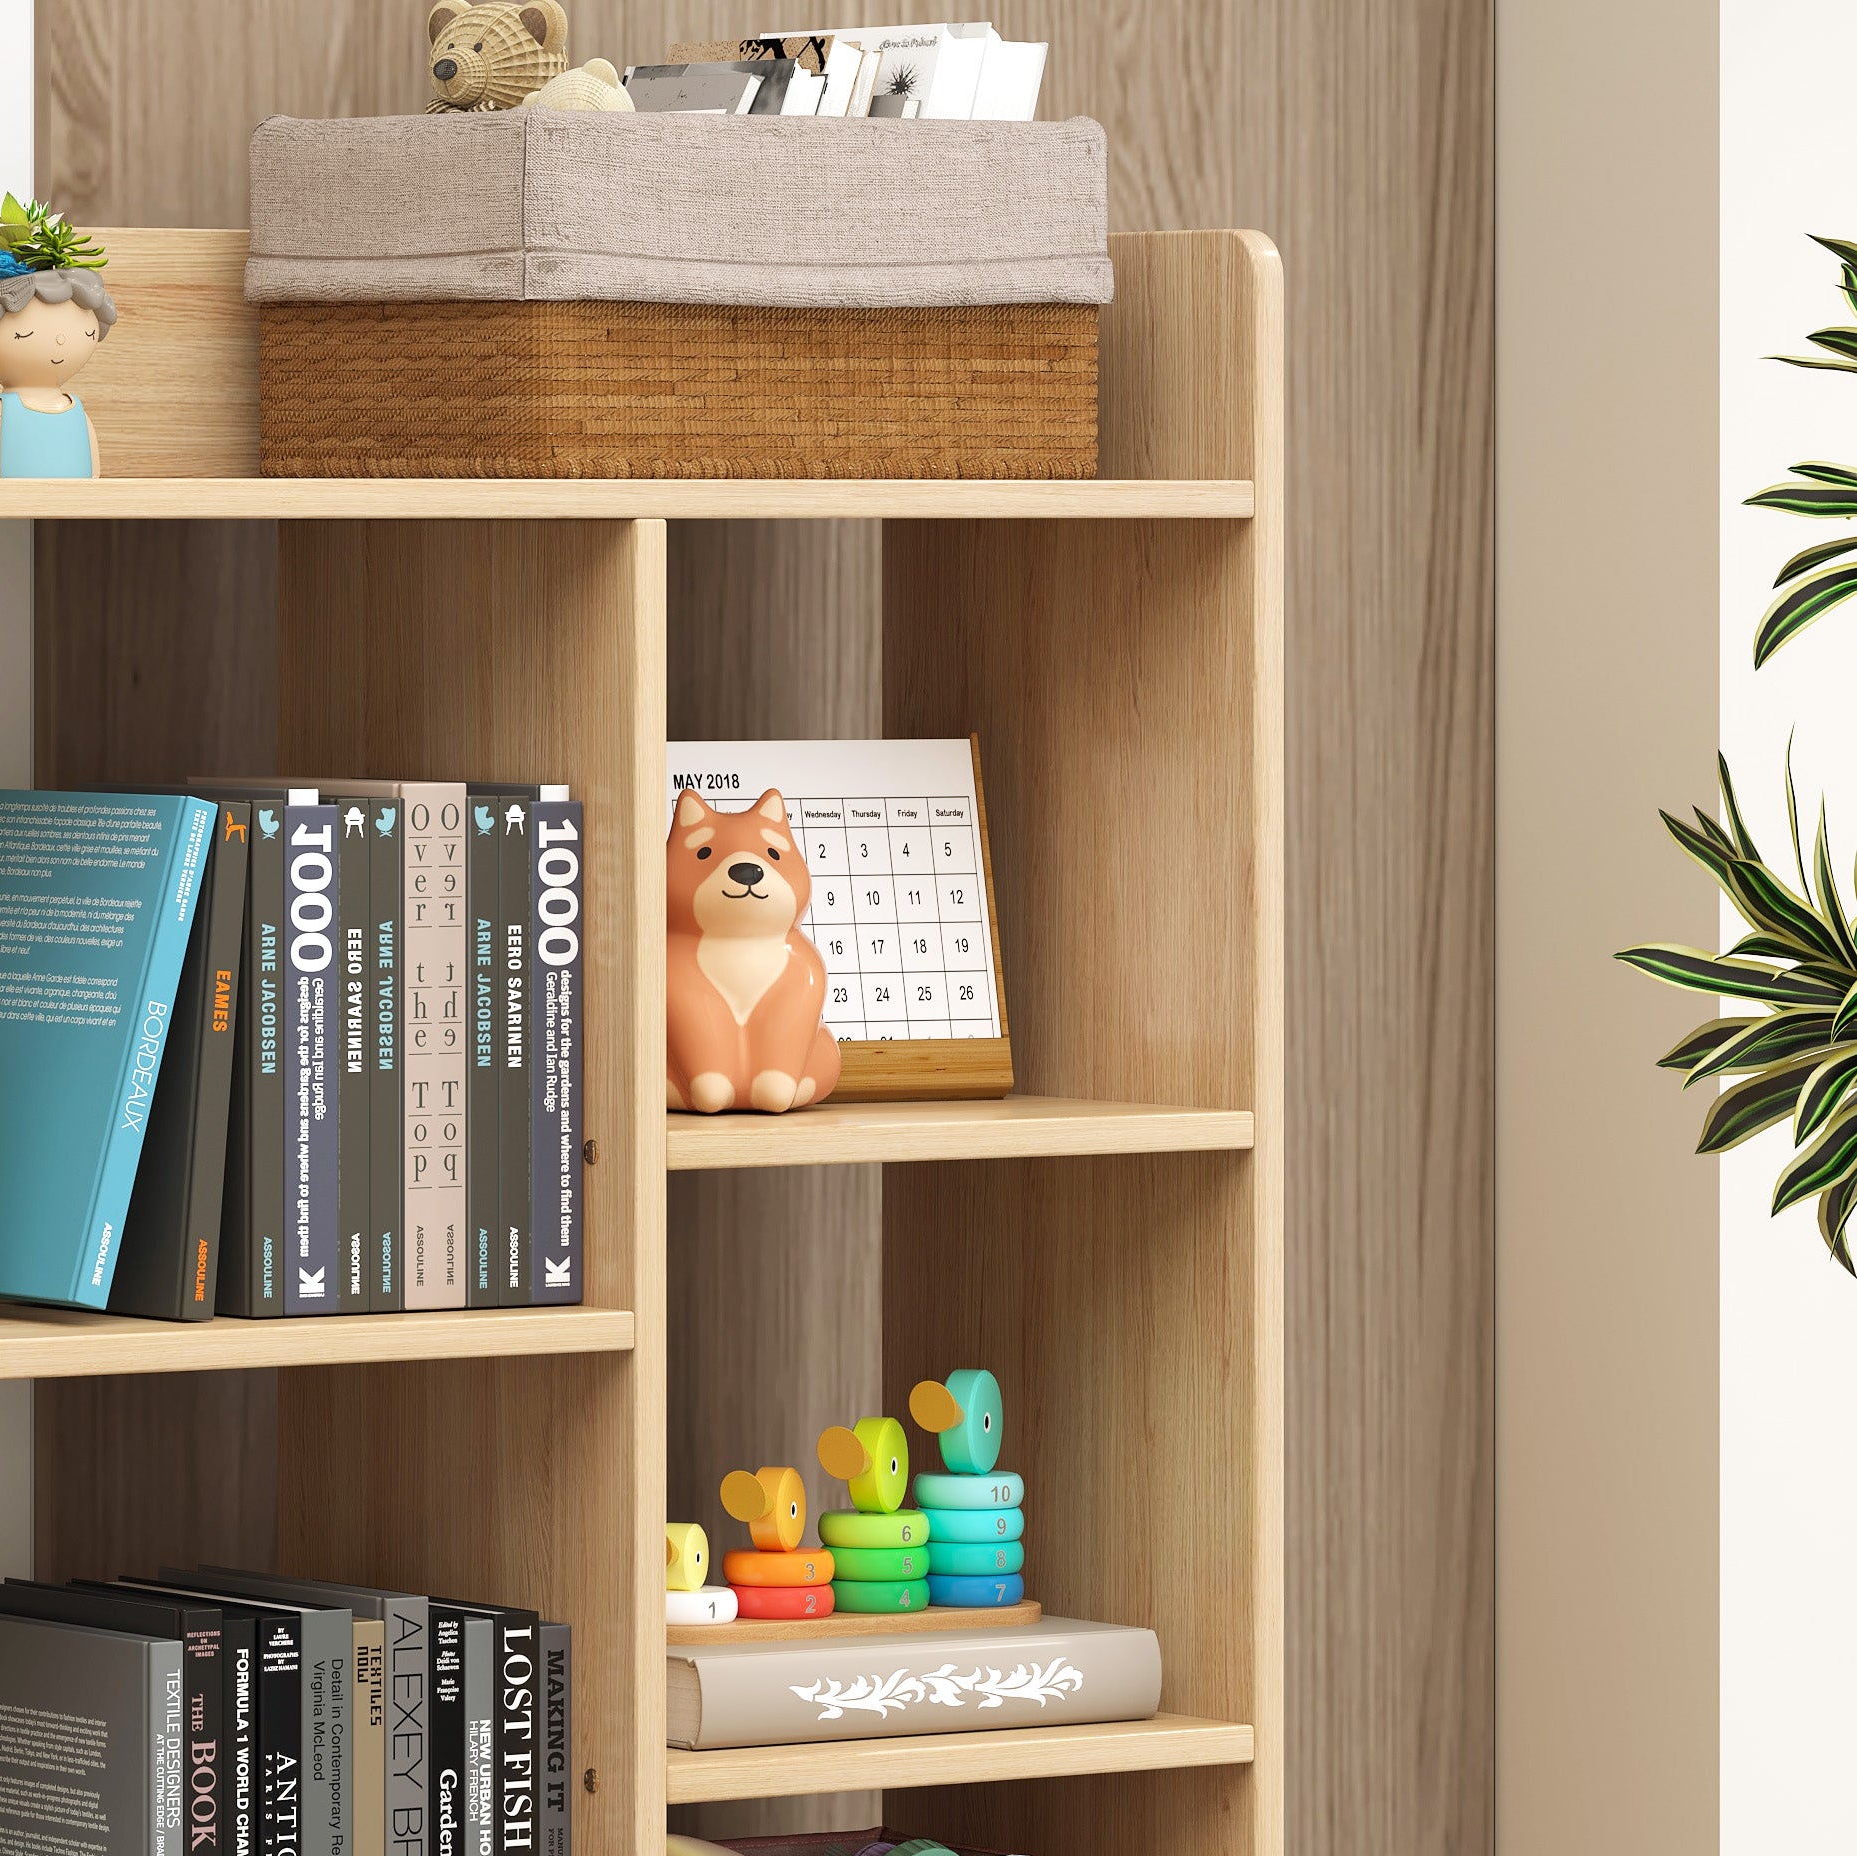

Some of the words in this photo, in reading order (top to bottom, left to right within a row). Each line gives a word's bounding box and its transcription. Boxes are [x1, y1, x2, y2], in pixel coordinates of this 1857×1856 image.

[673, 774, 702, 789] MAY
[706, 774, 740, 789] 2018
[804, 810, 842, 821] Wednesday
[851, 809, 881, 820] Thursday
[897, 809, 918, 819] Friday
[935, 808, 964, 819] Saturday
[818, 843, 827, 859] 2
[860, 843, 869, 858] 3
[902, 842, 910, 858] 4
[944, 842, 952, 857] 5
[537, 819, 579, 965] 1000
[827, 891, 835, 906] 9
[866, 890, 880, 906] 10
[908, 890, 921, 905] 11
[950, 889, 964, 905] 12
[261, 924, 276, 971] ARNE
[477, 919, 492, 965] ARNE
[507, 925, 523, 969] EERO
[829, 940, 843, 955] 16
[871, 939, 885, 955] 17
[913, 938, 927, 954] 18
[954, 939, 969, 952] 19
[212, 971, 232, 1031] EAMES
[545, 971, 559, 1029] Geraldine
[558, 970, 573, 1016] designs
[833, 988, 848, 1002] 23
[875, 988, 890, 1001] 24
[917, 987, 932, 1000] 25
[959, 986, 974, 1000] 26
[261, 979, 276, 1073] JACOBSEN
[476, 974, 492, 1066] JACOBSEN
[507, 978, 523, 1067] SAARINEN
[545, 1029, 559, 1052] and
[560, 1017, 573, 1037] for
[121, 1000, 167, 1133] BORDEAUX
[546, 1053, 558, 1074] Ian
[560, 1036, 573, 1059] the
[543, 1076, 559, 1112] Rudge
[558, 1060, 573, 1108] gardens
[560, 1109, 573, 1133] and
[560, 1133, 573, 1173] where
[560, 1173, 572, 1188] to
[560, 1188, 573, 1214] find
[560, 1214, 573, 1247] them
[92, 1222, 113, 1286] ASSOULINE
[194, 1238, 208, 1302] ASSOULINE
[263, 1236, 273, 1299] ASSOULINE
[416, 1225, 424, 1287] ASSOULINE
[509, 1226, 519, 1288] ASSOULINE
[990, 1486, 1011, 1502] 10
[900, 1524, 912, 1543] 6
[996, 1518, 1006, 1535] 9
[805, 1563, 815, 1580] 3
[901, 1556, 914, 1575] 5
[996, 1551, 1006, 1567] 8
[708, 1601, 716, 1619] 1
[805, 1595, 816, 1612] 2
[898, 1588, 911, 1608] 4
[996, 1584, 1006, 1601] 7
[166, 1669, 181, 1733] TEXTILE
[236, 1648, 249, 1731] FORMULA
[310, 1661, 326, 1716] Virginia
[331, 1658, 344, 1701] Detail
[370, 1645, 382, 1726] TEXTILES
[392, 1614, 423, 1789] ALEXEY
[503, 1626, 533, 1739] LOST
[191, 1693, 204, 1732] THE
[331, 1705, 344, 1719] in
[547, 1650, 565, 1773] MAKING
[236, 1734, 249, 1743] 1
[313, 1721, 326, 1781] McLeod
[469, 1720, 479, 1767] HILARY
[479, 1719, 492, 1760] NEW
[166, 1739, 181, 1828] DESIGNERS
[191, 1739, 217, 1851] BOOK
[236, 1746, 249, 1810] WORLD
[328, 1724, 344, 1829] Contemporary
[468, 1769, 479, 1822] FRENCH
[479, 1763, 492, 1826] URBAN
[547, 1782, 565, 1812] IT
[503, 1750, 533, 1850] FISH
